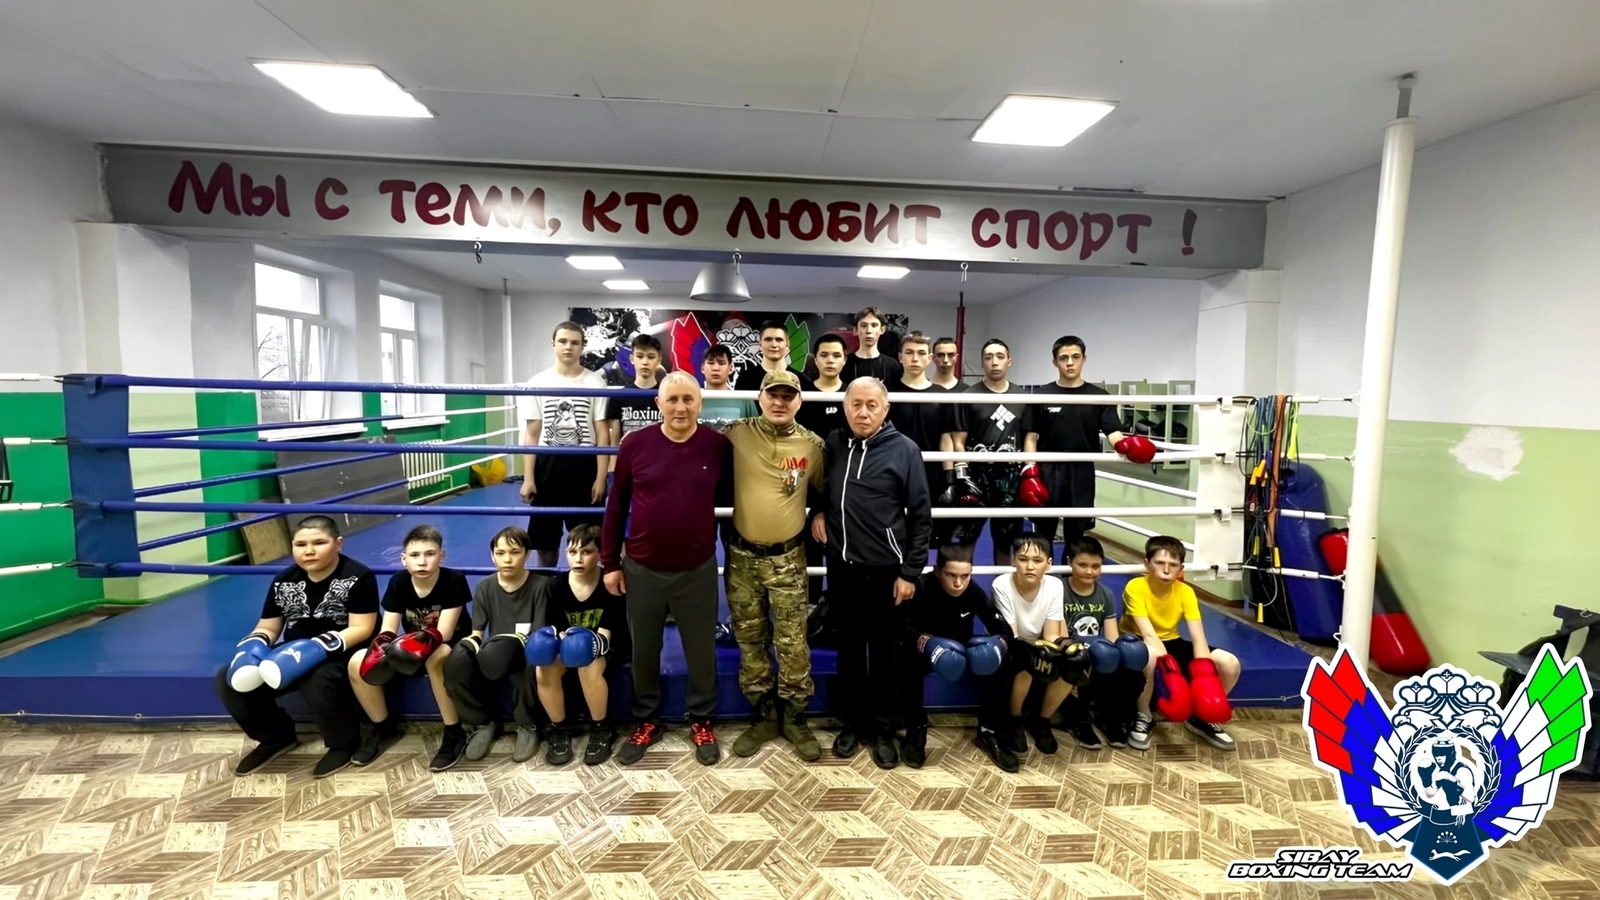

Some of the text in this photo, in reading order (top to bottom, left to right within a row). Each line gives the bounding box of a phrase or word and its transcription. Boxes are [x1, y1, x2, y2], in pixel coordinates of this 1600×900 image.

[168, 160, 290, 219] Мы
[314, 177, 350, 220] с
[1181, 208, 1198, 256] !
